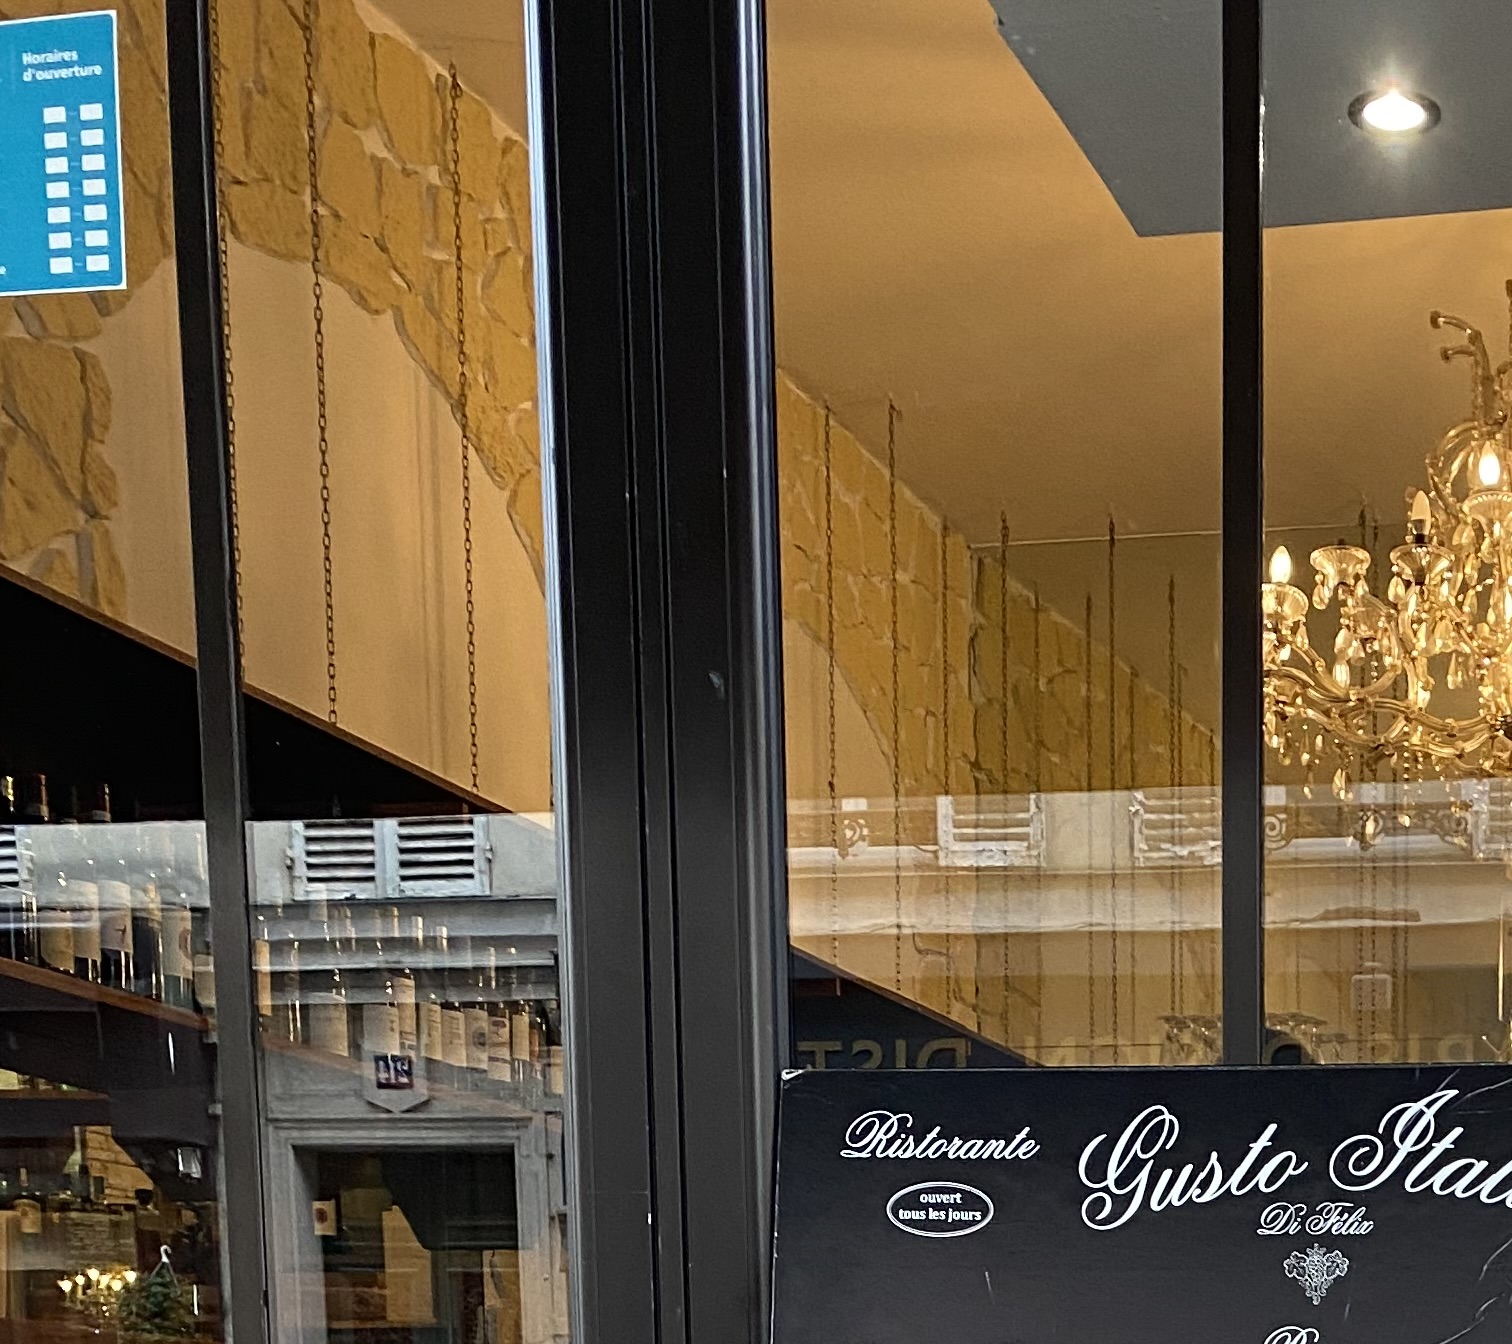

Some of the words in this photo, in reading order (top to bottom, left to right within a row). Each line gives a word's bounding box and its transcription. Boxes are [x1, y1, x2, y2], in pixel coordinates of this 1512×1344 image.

[22, 50, 78, 65] Horaires
[23, 65, 102, 82] d'ouverture
[840, 1110, 1040, 1159] Ristorante
[1078, 1104, 1308, 1230] Gusto
[919, 1192, 962, 1204] ouvert
[899, 1208, 926, 1220] tous
[929, 1208, 945, 1220] les
[948, 1208, 981, 1222] jours
[1257, 1202, 1307, 1235] Di
[1306, 1202, 1374, 1235] Félix
